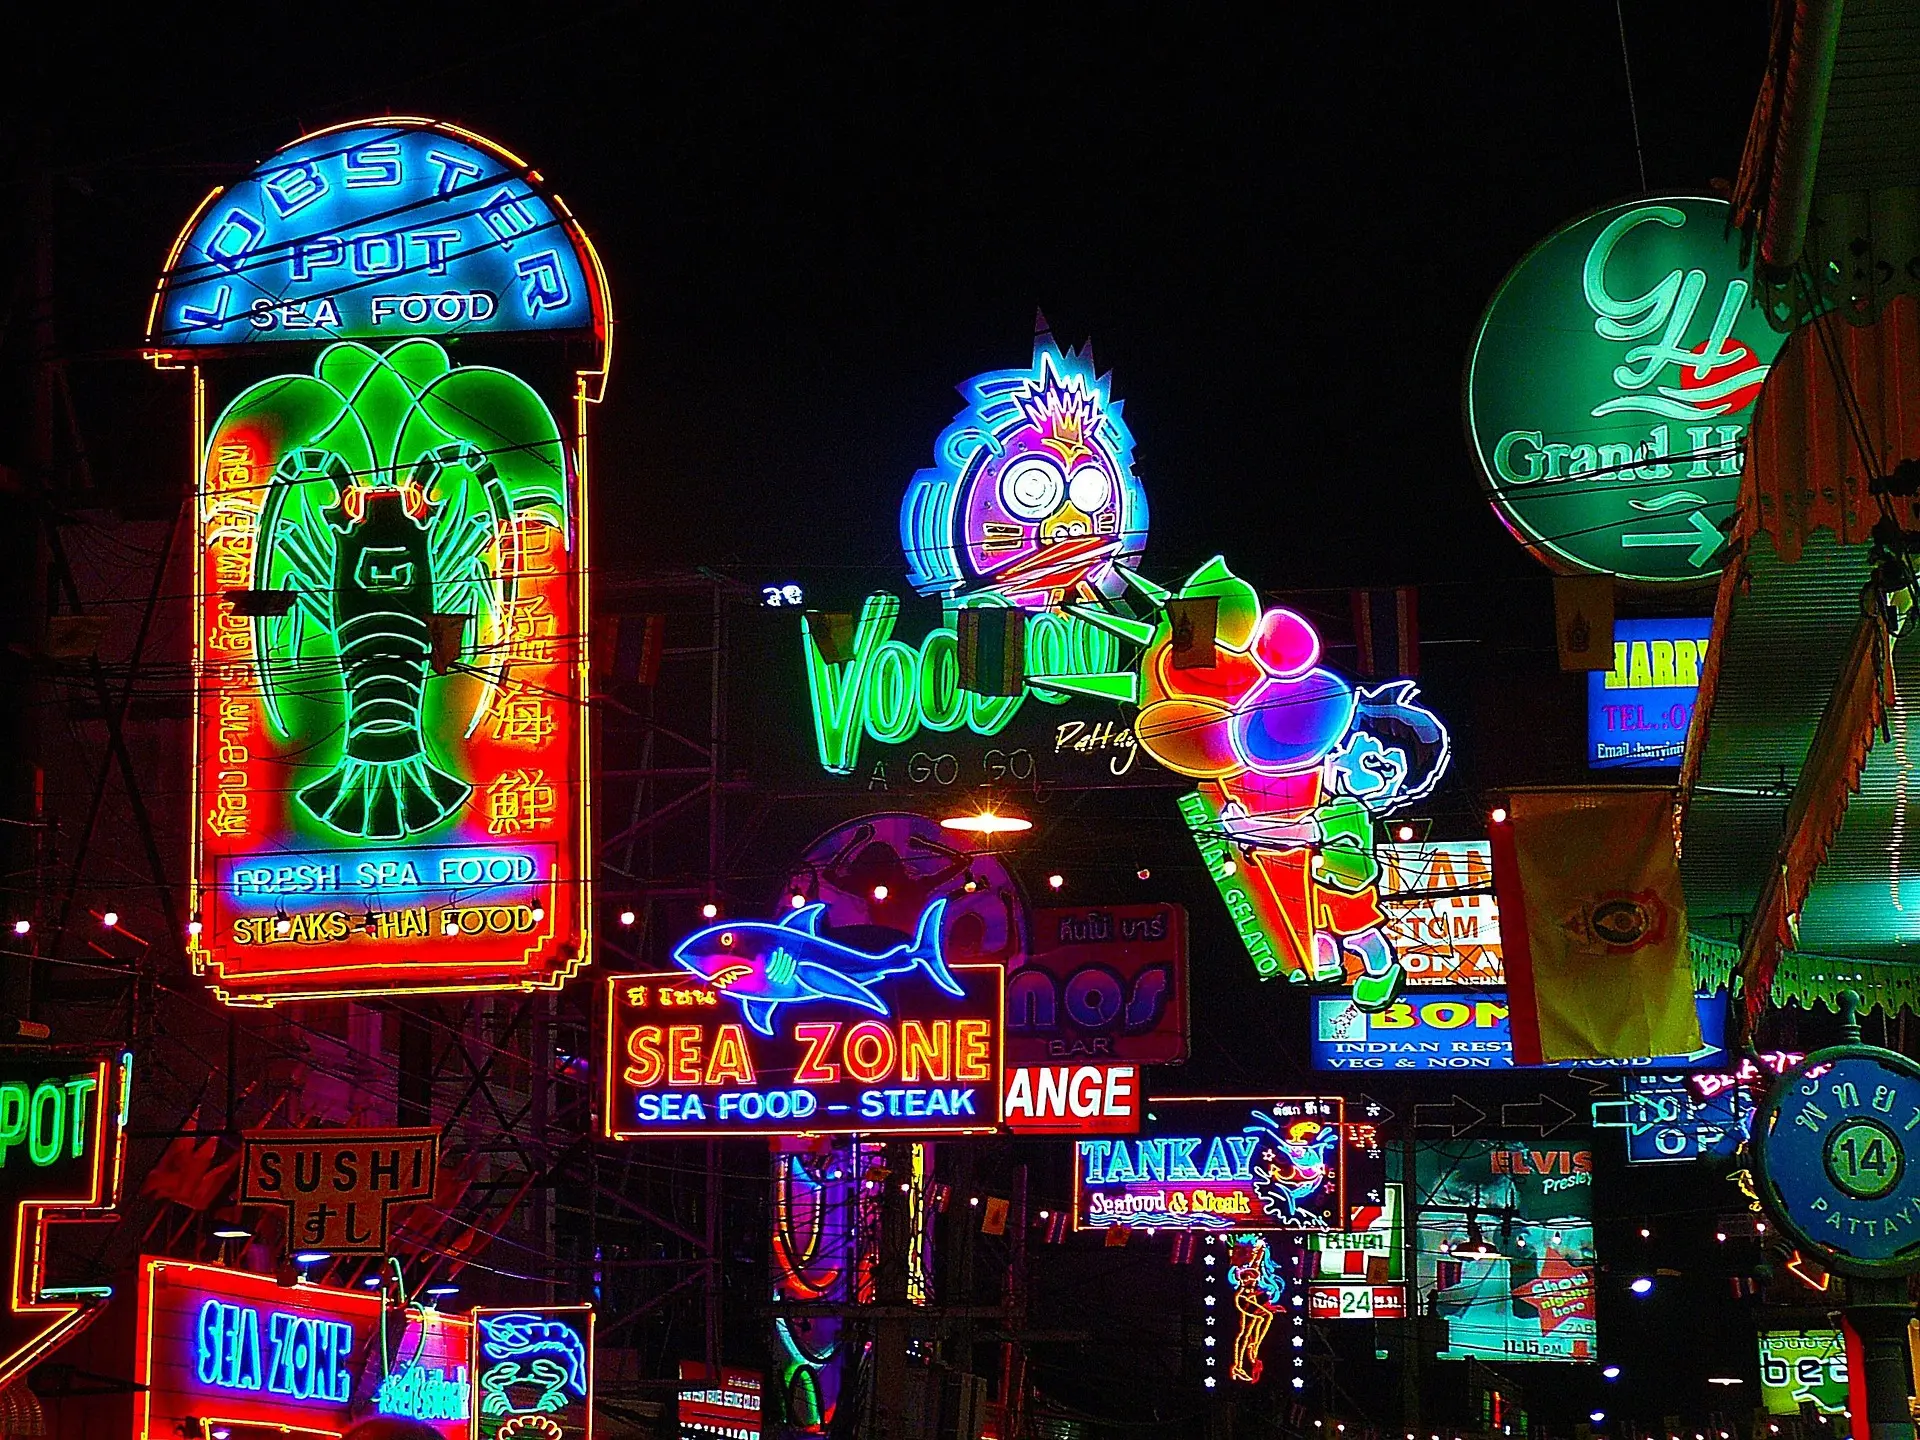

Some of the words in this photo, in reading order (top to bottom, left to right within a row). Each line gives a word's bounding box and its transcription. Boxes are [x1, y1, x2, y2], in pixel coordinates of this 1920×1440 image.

[181, 142, 571, 330] LOBSTER
[288, 229, 461, 282] POT
[250, 297, 343, 331] SEA
[371, 289, 500, 326] FOOD
[1494, 425, 1673, 485] Grand
[1686, 425, 1746, 479] H
[868, 760, 889, 790] A
[908, 751, 959, 785] GO
[983, 748, 1034, 781] GO
[233, 864, 340, 895] FRESH
[357, 860, 420, 889] SEA
[440, 855, 538, 886] FOOD
[233, 911, 347, 944] STEAKS
[440, 905, 534, 936] FOOD
[1225, 889, 1278, 977] GELATO
[624, 1024, 757, 1086] SEA
[793, 1019, 991, 1085] ZONE
[1049, 1037, 1110, 1056] BAR
[1328, 1057, 1384, 1068] VEG
[1395, 1057, 1416, 1068] &
[1428, 1057, 1491, 1068] NON
[1335, 1042, 1440, 1053] INDIAN
[637, 1093, 706, 1121] SEA
[719, 1088, 816, 1119] FOOD
[860, 1087, 976, 1118] STEAK
[1005, 1065, 1135, 1118] ANGE
[0, 1073, 97, 1168] POT
[257, 1149, 423, 1193] SUSHI
[1081, 1136, 1260, 1184] TANKAY
[1491, 1150, 1593, 1175] ELVIS
[1840, 1137, 1888, 1177] 14
[1090, 1190, 1167, 1215] Seafood
[1168, 1193, 1188, 1215] &
[1542, 1172, 1593, 1195] Presley
[302, 1202, 372, 1245] すし
[1342, 1291, 1371, 1313] 24
[198, 1300, 262, 1390] SEA
[268, 1312, 354, 1403] ZONE
